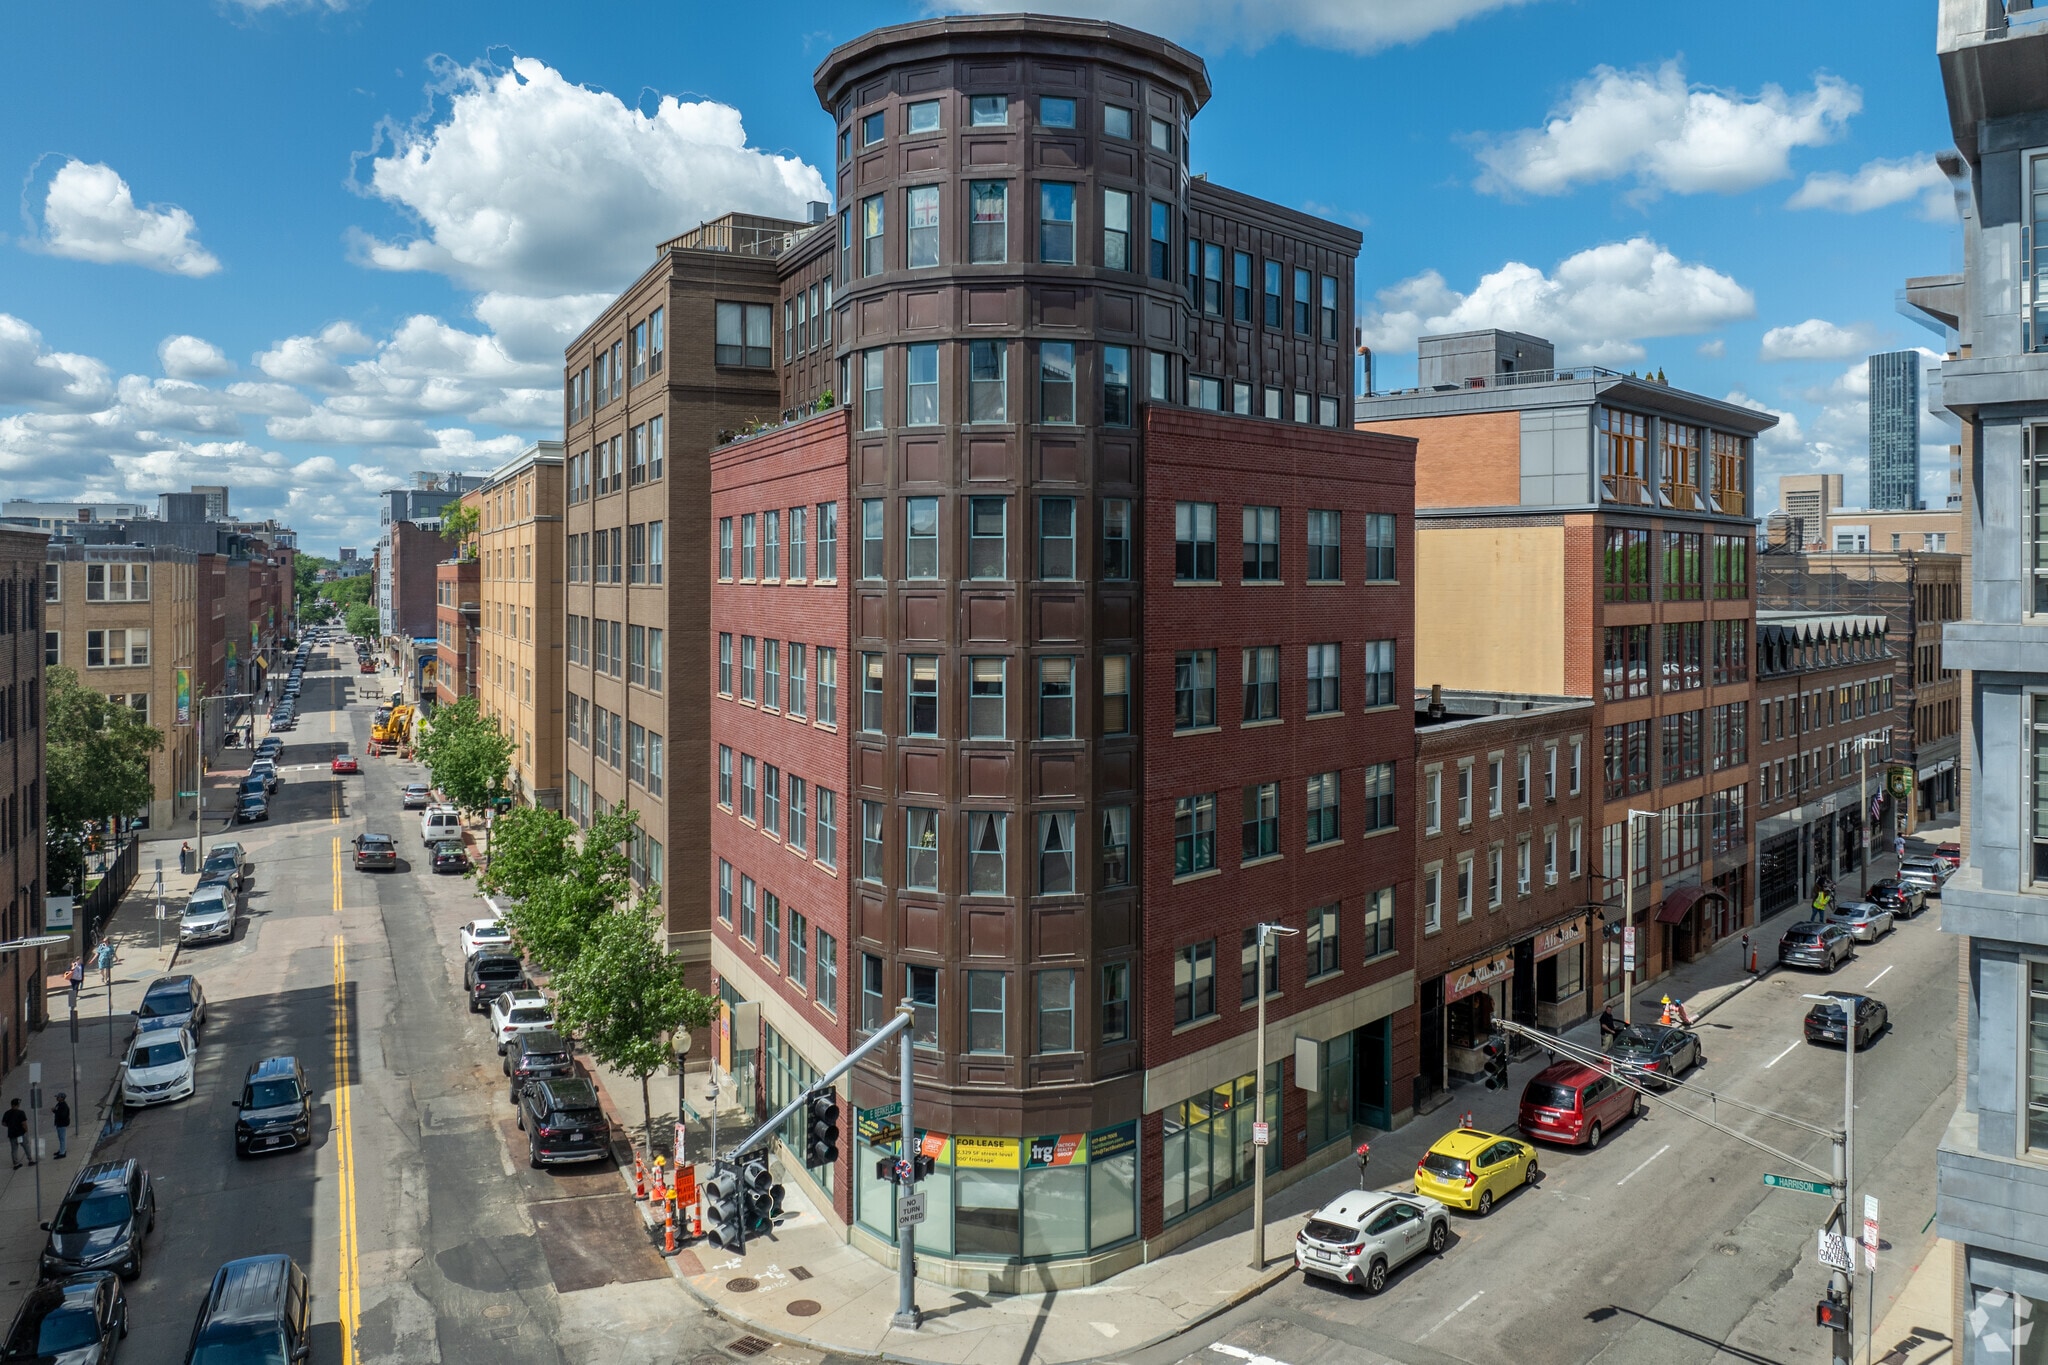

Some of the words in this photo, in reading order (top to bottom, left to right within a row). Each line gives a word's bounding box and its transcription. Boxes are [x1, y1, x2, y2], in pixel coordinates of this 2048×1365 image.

[874, 1103, 897, 1118] BERKELEY
[956, 1138, 975, 1146] FOR
[976, 1139, 1005, 1148] LEASE
[1031, 1145, 1054, 1162] trg
[1778, 1177, 1814, 1192] HARRISON
[907, 1199, 916, 1207] NO
[903, 1205, 920, 1215] TURN
[910, 1212, 923, 1220] RED
